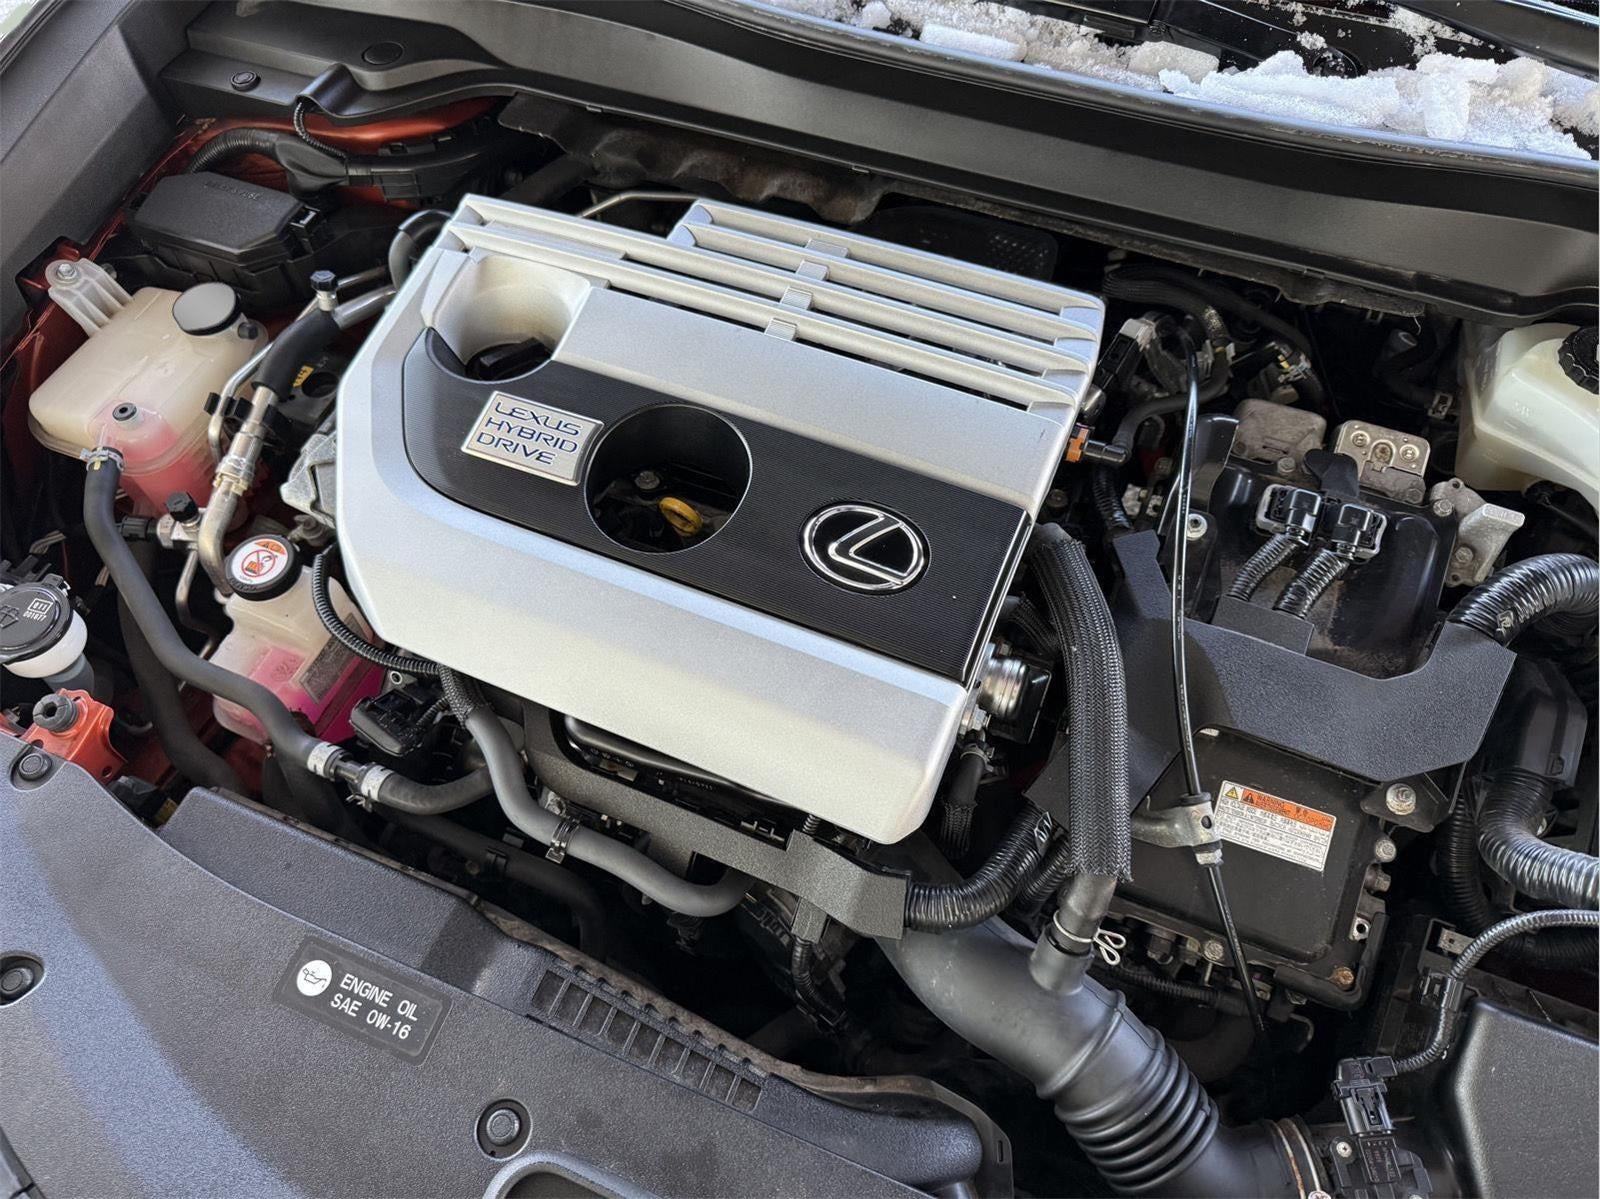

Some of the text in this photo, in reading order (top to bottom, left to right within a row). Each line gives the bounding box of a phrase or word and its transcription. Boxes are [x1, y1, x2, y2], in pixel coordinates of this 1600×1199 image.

[485, 417, 578, 453] HYBRID
[495, 401, 582, 436] LEXUS
[476, 432, 556, 465] DRIVE
[340, 973, 419, 1021] ENGINE OIL
[330, 993, 411, 1040] SAE 0W-16
